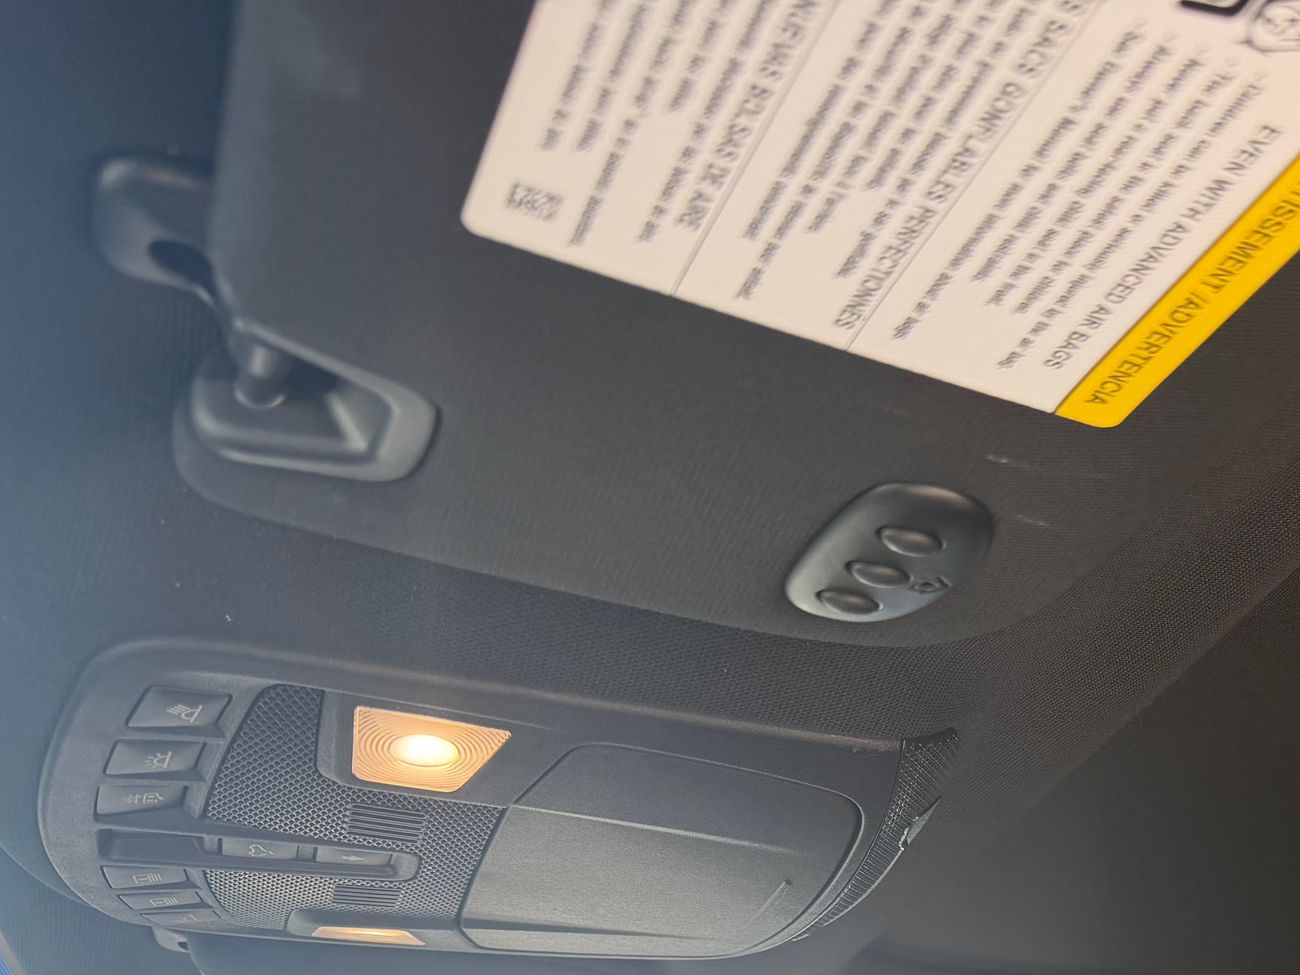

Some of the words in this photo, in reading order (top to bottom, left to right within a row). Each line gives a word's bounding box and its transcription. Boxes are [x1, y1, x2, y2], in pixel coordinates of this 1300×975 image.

[1011, 18, 1072, 81] SACS
[712, 83, 774, 163] BOLSAS
[922, 79, 1028, 205] GONFLABLES
[1220, 123, 1282, 177] EVEN
[698, 161, 731, 190] DE
[674, 188, 716, 232] AIRE
[1179, 175, 1234, 222] WITH
[1080, 224, 1136, 274] seriously
[1101, 220, 1192, 306] ADVANCED
[1049, 271, 1095, 309] injured
[1026, 320, 1053, 338] the
[1037, 306, 1064, 322] by
[1077, 303, 1115, 331] AIR
[1013, 336, 1037, 352] air
[1040, 329, 1091, 371] BAGS
